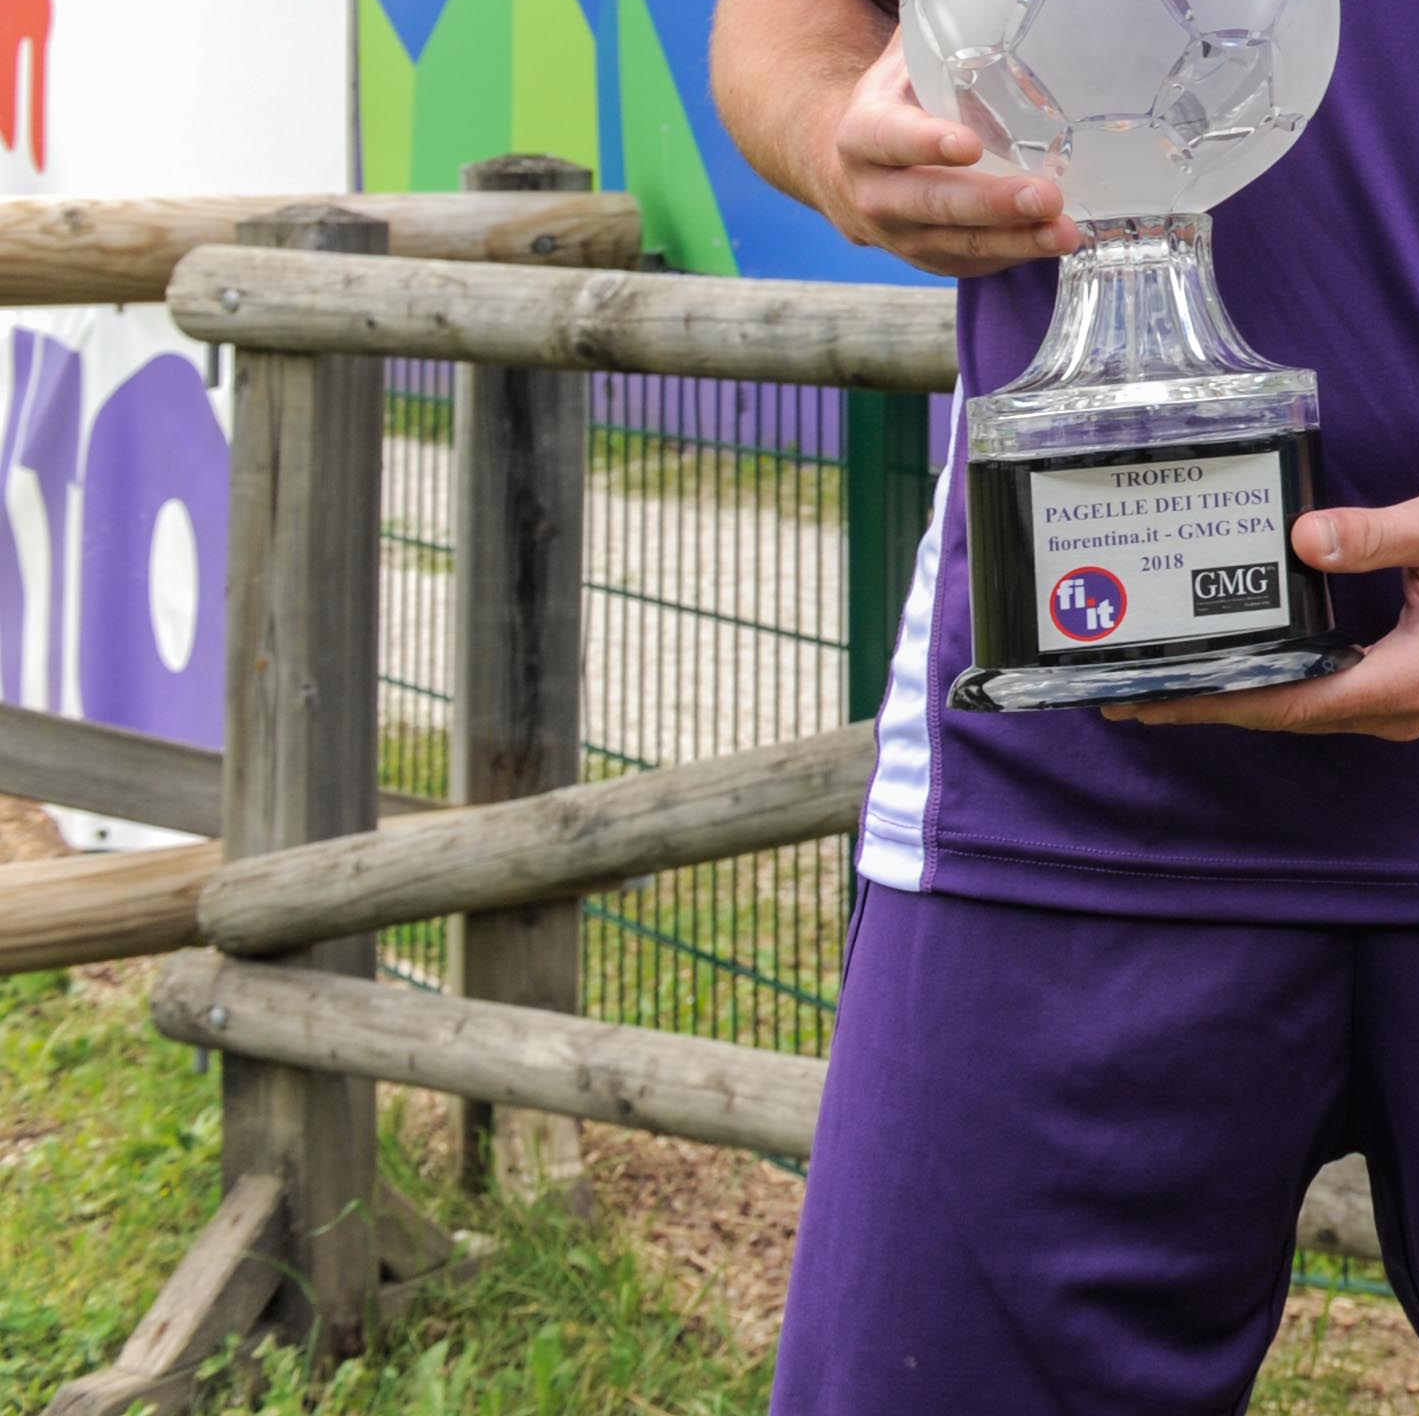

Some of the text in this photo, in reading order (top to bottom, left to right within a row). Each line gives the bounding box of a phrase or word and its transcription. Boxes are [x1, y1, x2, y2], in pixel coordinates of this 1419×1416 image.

[1111, 465, 1204, 489] TROFEO
[1045, 488, 1270, 523] PAGELLE DEI TIFOSI
[1048, 527, 1159, 552] fiorentina.it
[1178, 520, 1232, 540] GMG
[1237, 517, 1276, 535] SPA
[1141, 552, 1185, 572] 2018
[1194, 566, 1269, 599] GMG
